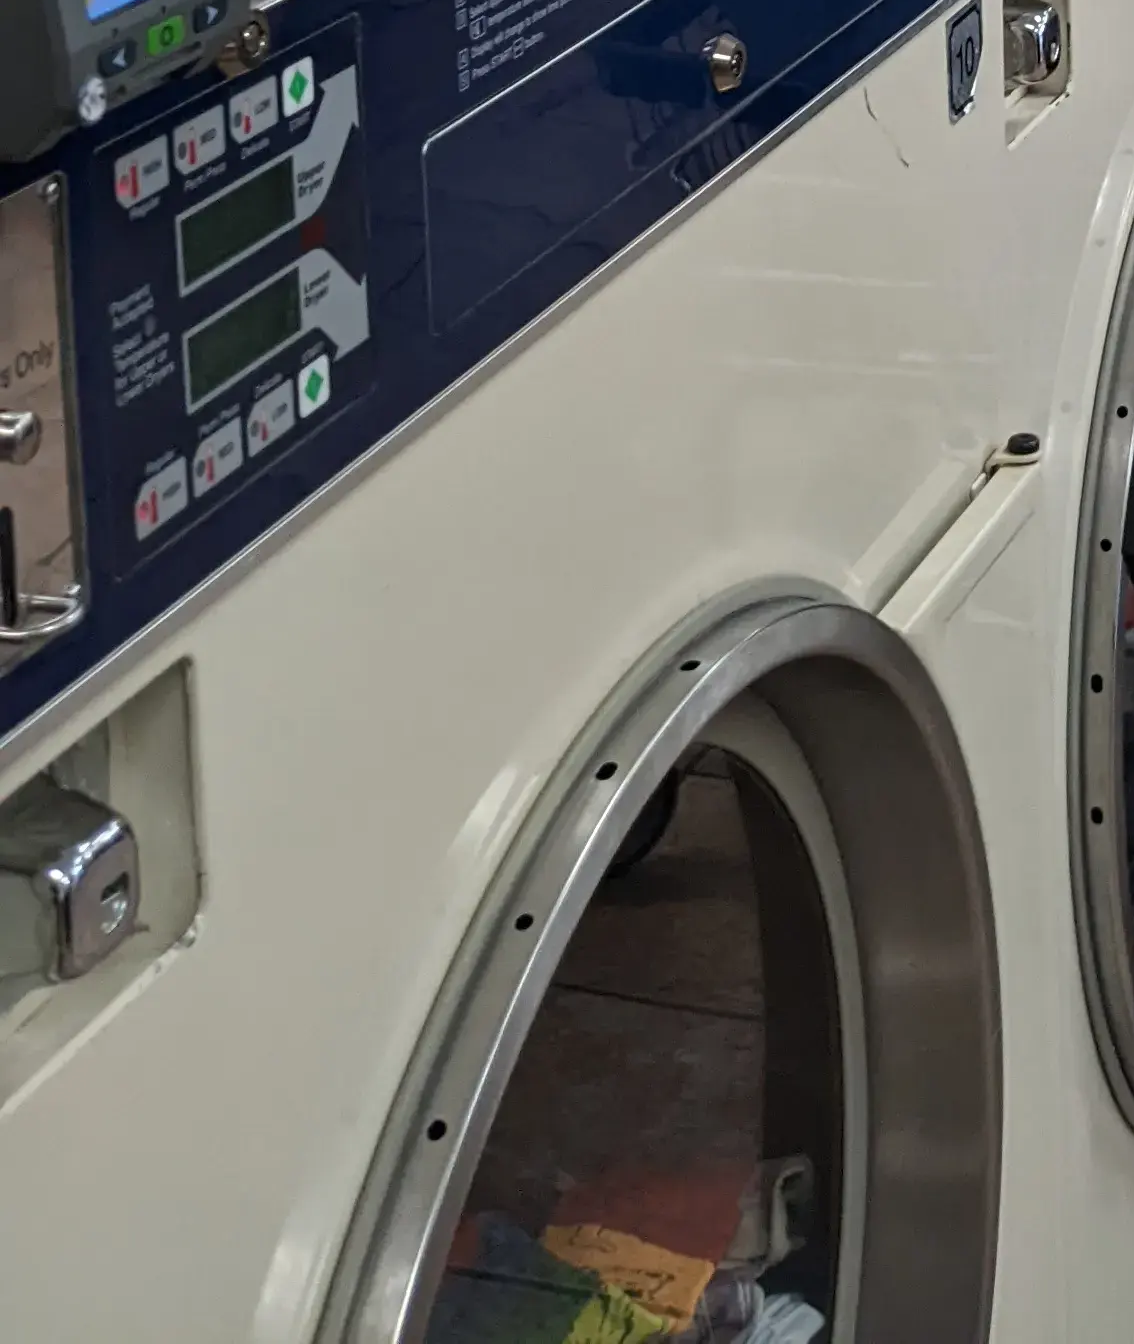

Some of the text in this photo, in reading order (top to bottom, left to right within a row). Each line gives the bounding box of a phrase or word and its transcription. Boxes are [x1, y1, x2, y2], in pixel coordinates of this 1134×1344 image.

[956, 36, 975, 84] 10
[297, 161, 326, 183] Upper
[298, 178, 324, 197] Dryer
[304, 269, 331, 294] Lower
[304, 286, 330, 308] Dryer
[15, 340, 54, 379] Only
